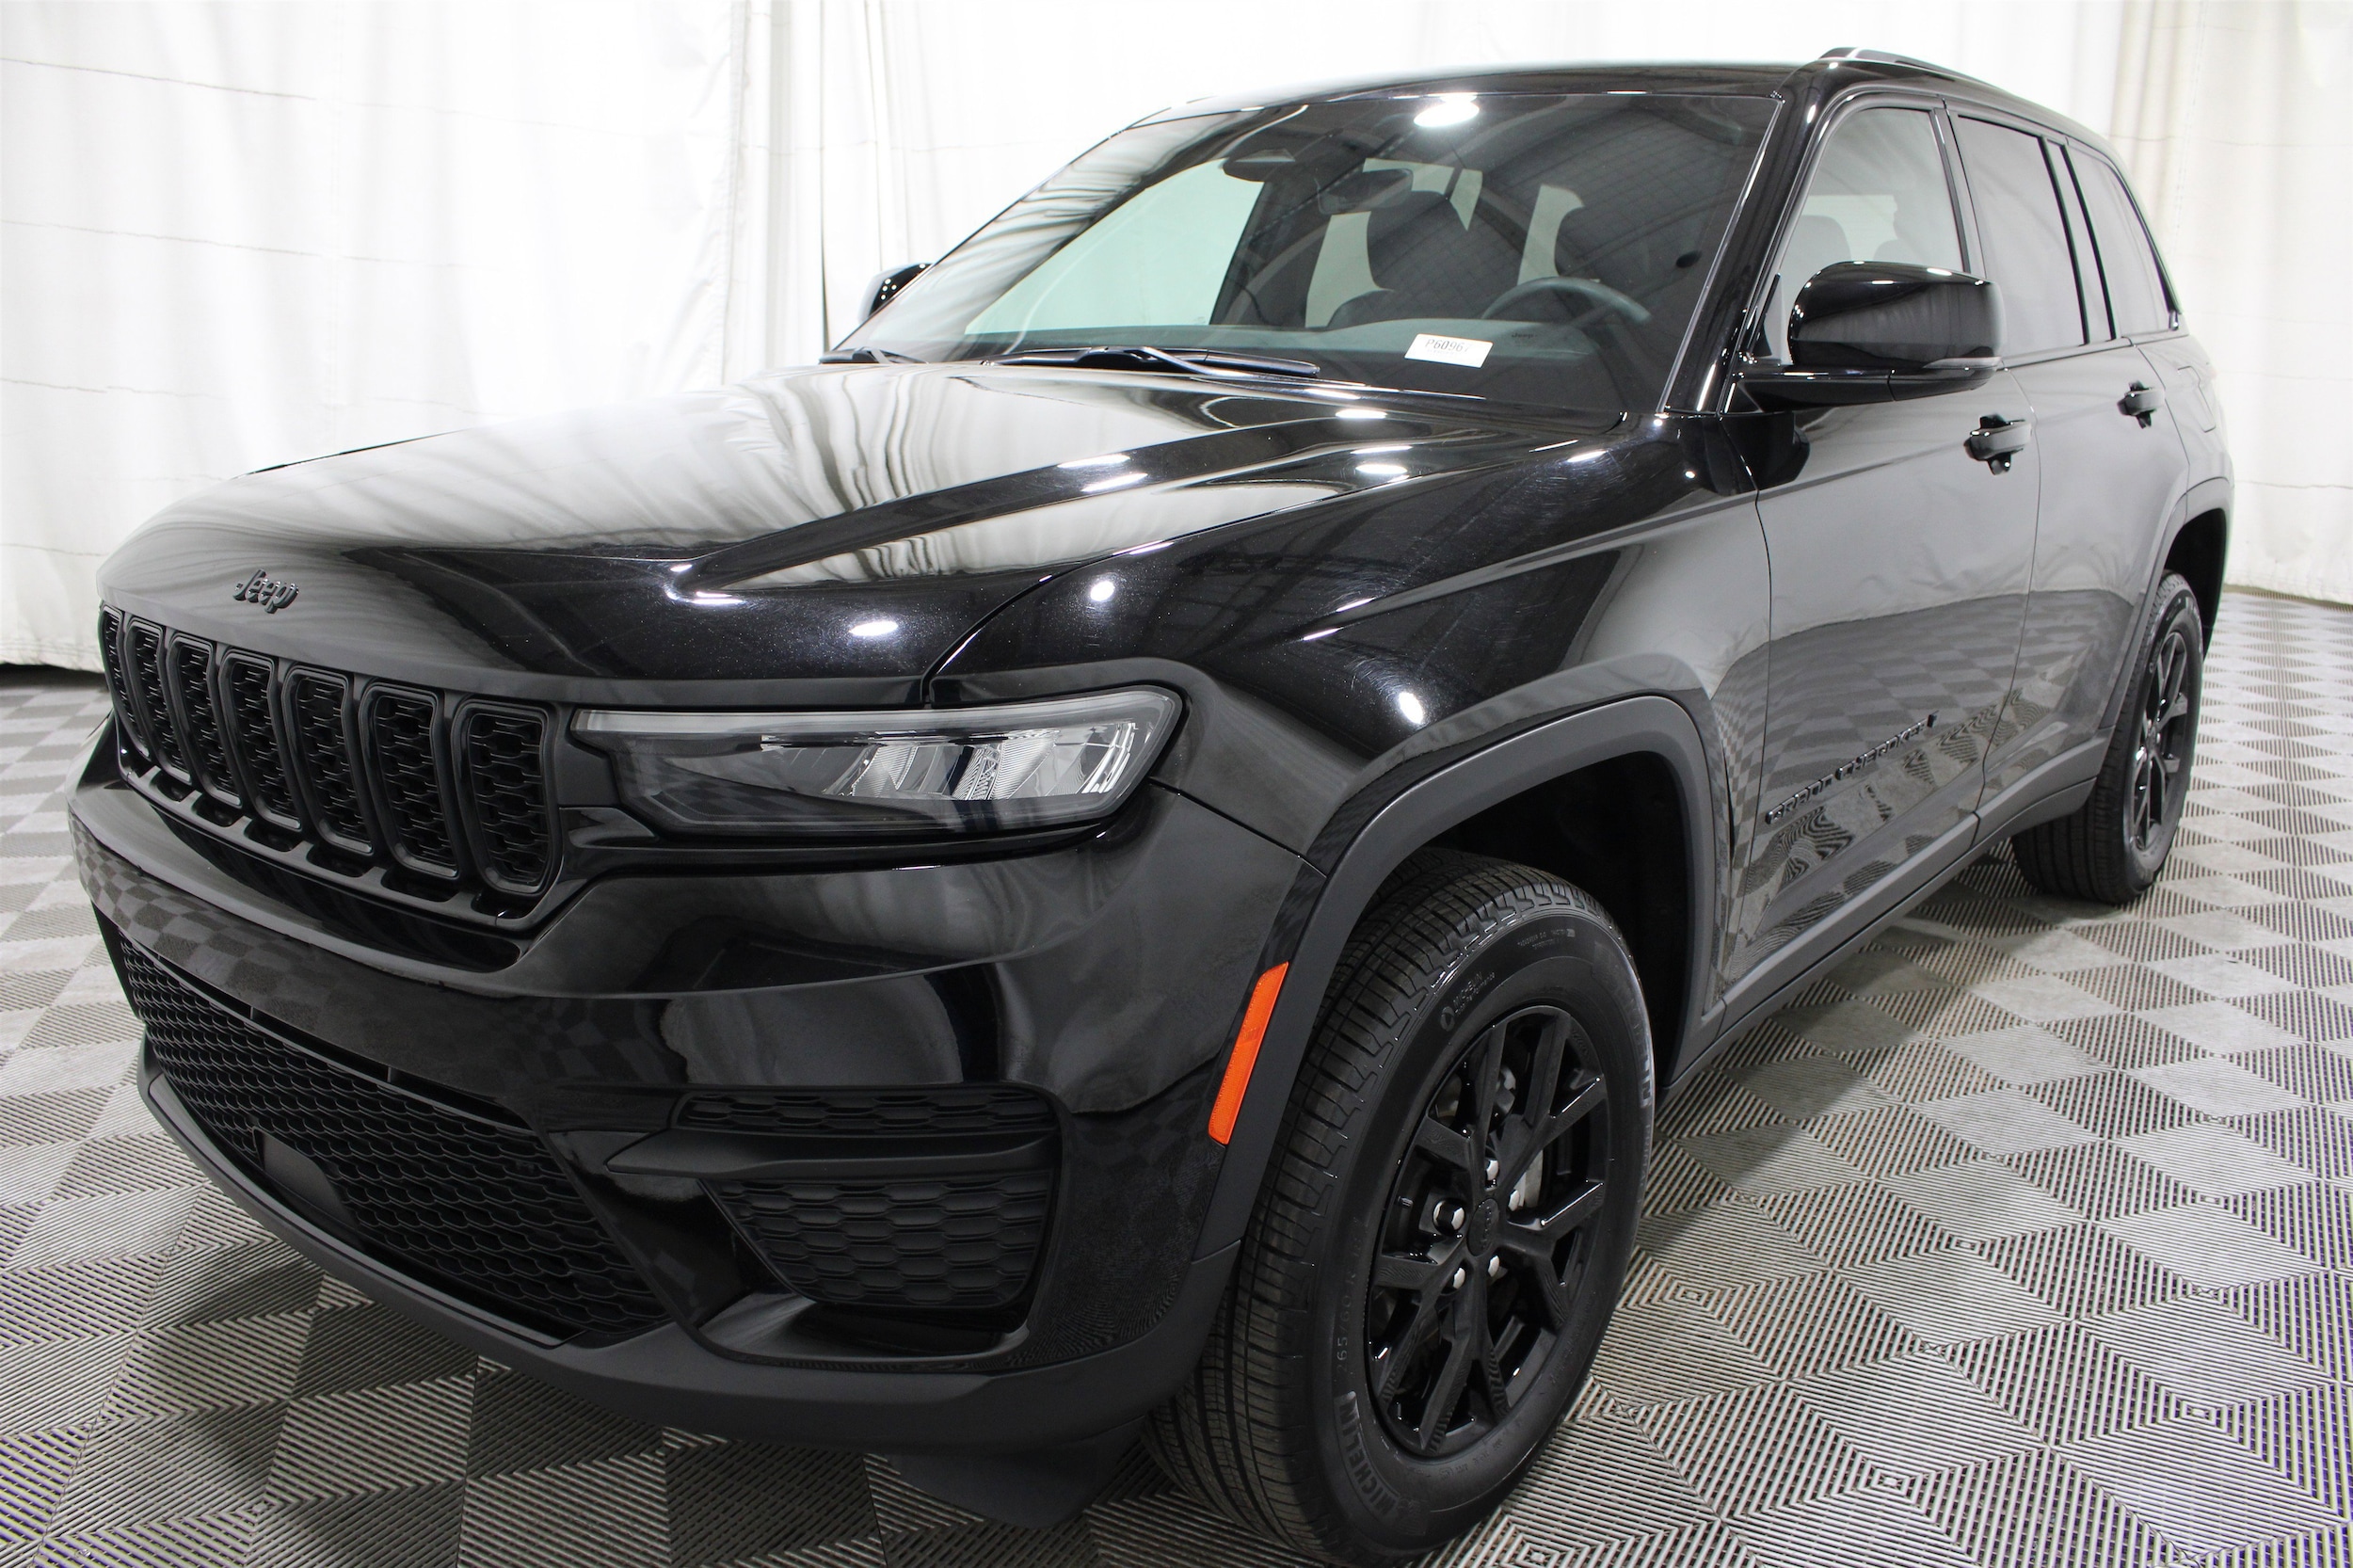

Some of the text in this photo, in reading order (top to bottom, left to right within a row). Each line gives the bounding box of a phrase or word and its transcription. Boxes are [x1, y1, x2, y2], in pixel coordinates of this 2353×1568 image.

[232, 568, 299, 614] Jeep
[1337, 1295, 1353, 1373] 265/60
[1338, 1401, 1397, 1515] MICHELIN
